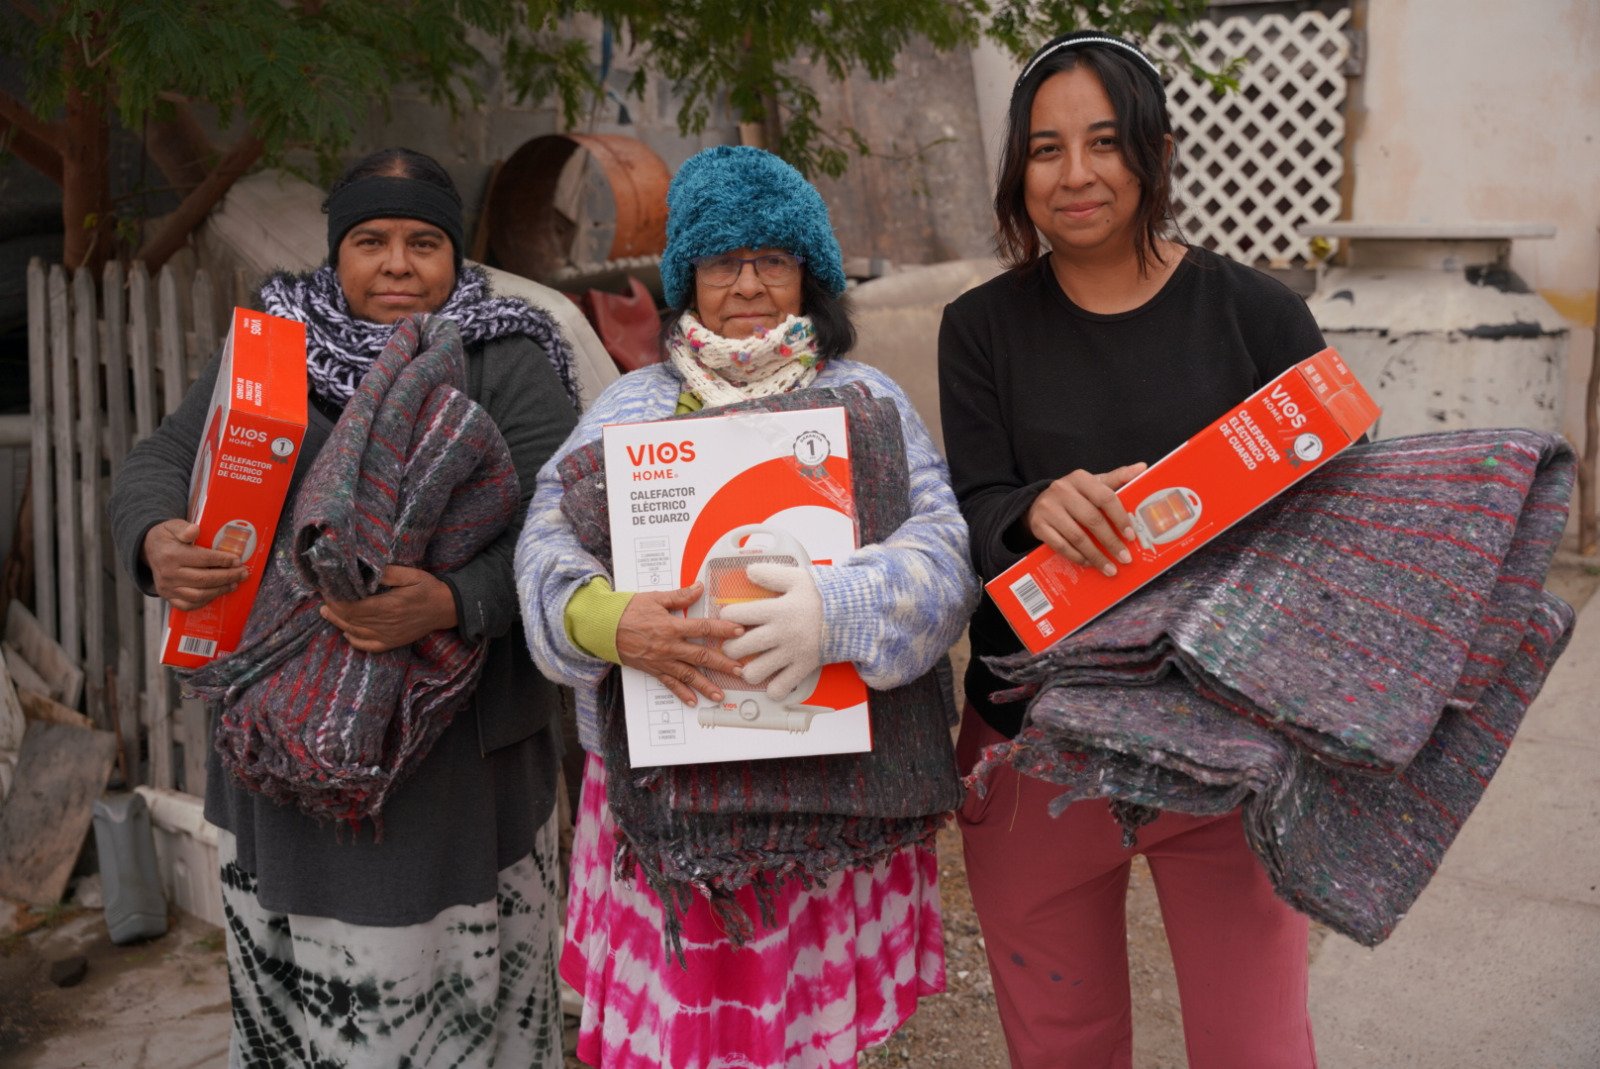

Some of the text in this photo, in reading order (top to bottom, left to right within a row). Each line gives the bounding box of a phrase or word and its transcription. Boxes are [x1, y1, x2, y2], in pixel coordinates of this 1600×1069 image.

[1271, 384, 1307, 428] VIOS
[229, 424, 268, 443] VIOS
[1228, 416, 1266, 462] ELÉCTRICO
[1238, 410, 1281, 463] CALEFACTOR
[228, 437, 252, 447] HOME
[279, 441, 286, 452] 1
[806, 439, 816, 457] 1
[1219, 423, 1257, 471] DE CUARZO
[1303, 440, 1316, 452] 1
[626, 440, 696, 467] VIOS
[220, 461, 263, 476] ELÉCTRICO
[222, 454, 272, 470] CALEFACTOR
[217, 469, 263, 484] DE CUARZO
[632, 468, 674, 481] HOME
[630, 486, 696, 501] CALEFACTOR
[631, 499, 686, 513] ELÉCTRICO
[632, 512, 690, 526] DE CUARZO
